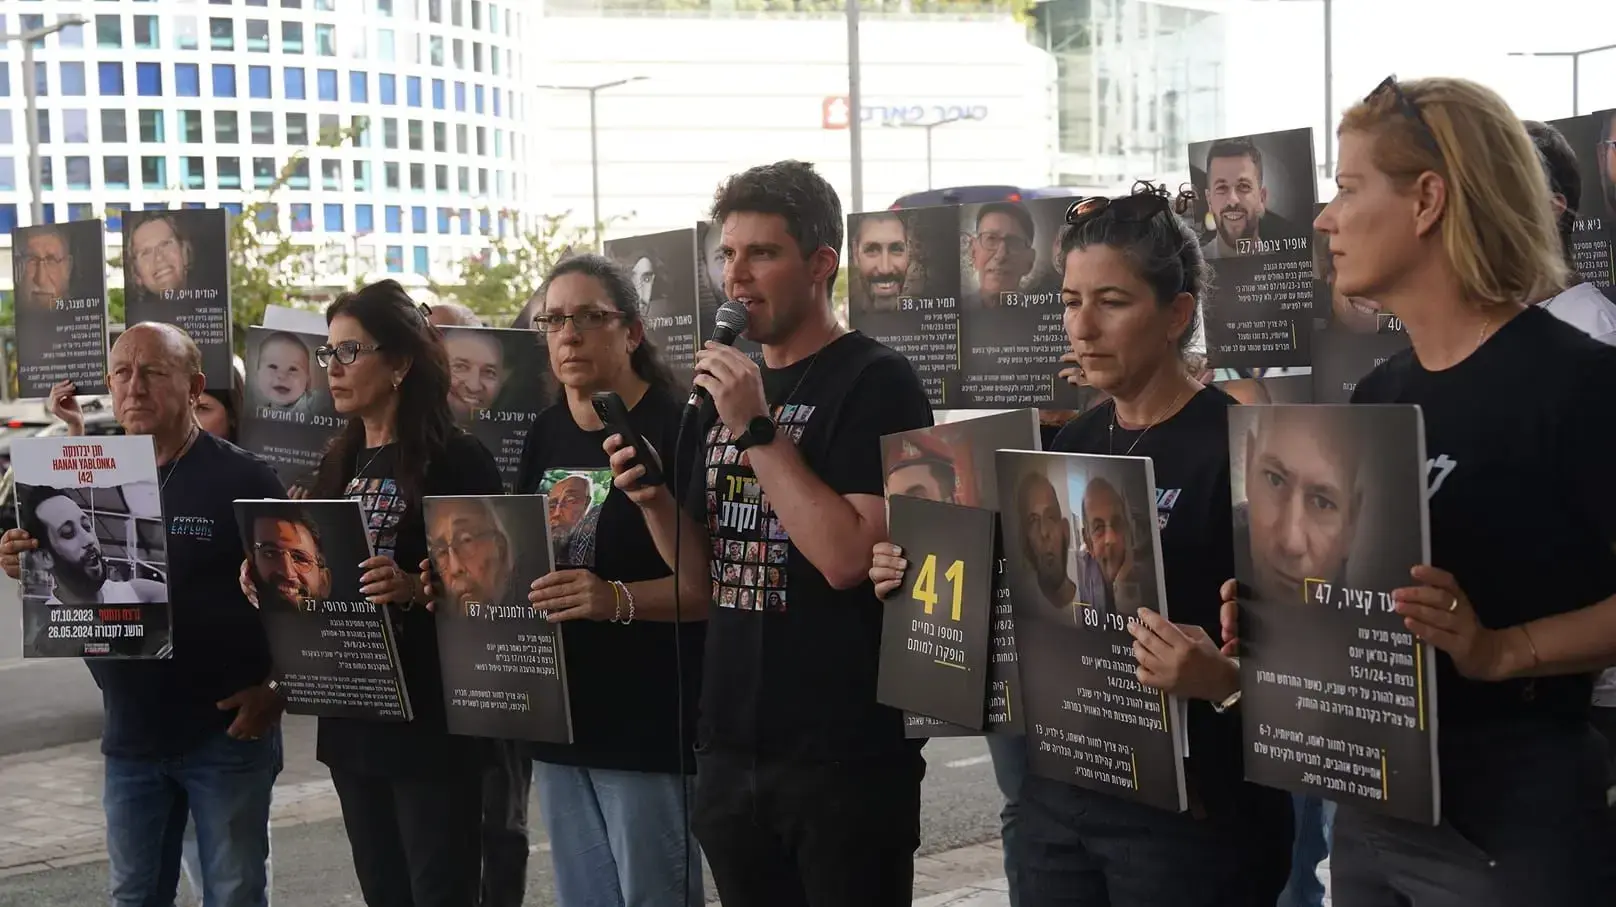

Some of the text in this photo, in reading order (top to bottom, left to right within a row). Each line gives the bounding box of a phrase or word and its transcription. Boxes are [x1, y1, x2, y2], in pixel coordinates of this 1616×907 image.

[1240, 237, 1307, 255] אופיר צרפתי, 27
[164, 289, 218, 300] יהודית וייס, 67
[1007, 292, 1053, 308] ליפשיץ, 83
[902, 297, 955, 311] תמיר אדר, 38
[1388, 317, 1401, 331] 40
[262, 409, 349, 428] פיר ביבס, 10 חודשים
[480, 410, 537, 422] סי שרעבי, 54
[63, 445, 103, 457] חנן יבלונקה
[53, 458, 116, 470] HANAN YABLONKA
[78, 471, 93, 483] (42)
[912, 554, 964, 622] 41
[1315, 583, 1396, 615] עד קציר, 47
[305, 600, 376, 613] אלמוג סרוסי, 27
[470, 604, 480, 617] 87
[51, 609, 94, 622] 07.10.2023
[1084, 608, 1098, 627] 80
[1104, 613, 1124, 631] פרי,
[48, 624, 144, 638] הושב לקבורה 26.05.2024
[912, 620, 963, 642] נחטפו בחיים
[1358, 628, 1412, 647] נחטף מניר עוז
[907, 638, 964, 663] הופקרו למותם
[1112, 644, 1121, 654] עוז
[1349, 646, 1364, 658] יונס
[1082, 656, 1093, 665] יונס
[1113, 662, 1136, 674] במנהרה
[1277, 674, 1302, 688] התרחש
[1350, 666, 1414, 687] נרצח ב-15/1/24
[1107, 676, 1141, 692] ב-14/2/24
[1303, 678, 1323, 692] כאשר
[1077, 688, 1092, 699] שוביו
[1102, 691, 1111, 702] על
[1348, 686, 1358, 697] ידי
[1359, 687, 1370, 700] על
[1372, 690, 1393, 704] להורג
[1113, 694, 1124, 705] בירי
[1126, 697, 1142, 708] להורג
[1320, 700, 1330, 712] בה
[1395, 696, 1415, 708] הוצא
[1102, 707, 1112, 718] חיל
[1145, 701, 1160, 712] הוצא
[1332, 702, 1354, 717] הדירה
[1114, 710, 1137, 723] הפצצות
[1356, 706, 1380, 724] בקרבת
[1404, 714, 1416, 728] של
[1036, 724, 1042, 735] 13
[1138, 716, 1162, 730] בעקבות
[1060, 730, 1064, 739] 5
[1259, 724, 1271, 737] ל-6
[1087, 737, 1102, 749] לחזור
[1104, 742, 1116, 753] צריך
[1327, 738, 1346, 752] לחזור
[1118, 746, 1129, 755] היה
[1270, 746, 1294, 762] ולקיבוץ
[1347, 743, 1363, 757] צריך
[1366, 748, 1380, 760] היה
[1085, 753, 1093, 763] ניר
[1095, 756, 1112, 769] קהילת
[1296, 751, 1321, 766] לחברים
[1095, 771, 1110, 783] חבריו
[1111, 776, 1133, 788] ועשרות
[1324, 777, 1346, 791] ולמכבי
[1348, 782, 1356, 793] לו
[1358, 786, 1381, 800] שחיכה
